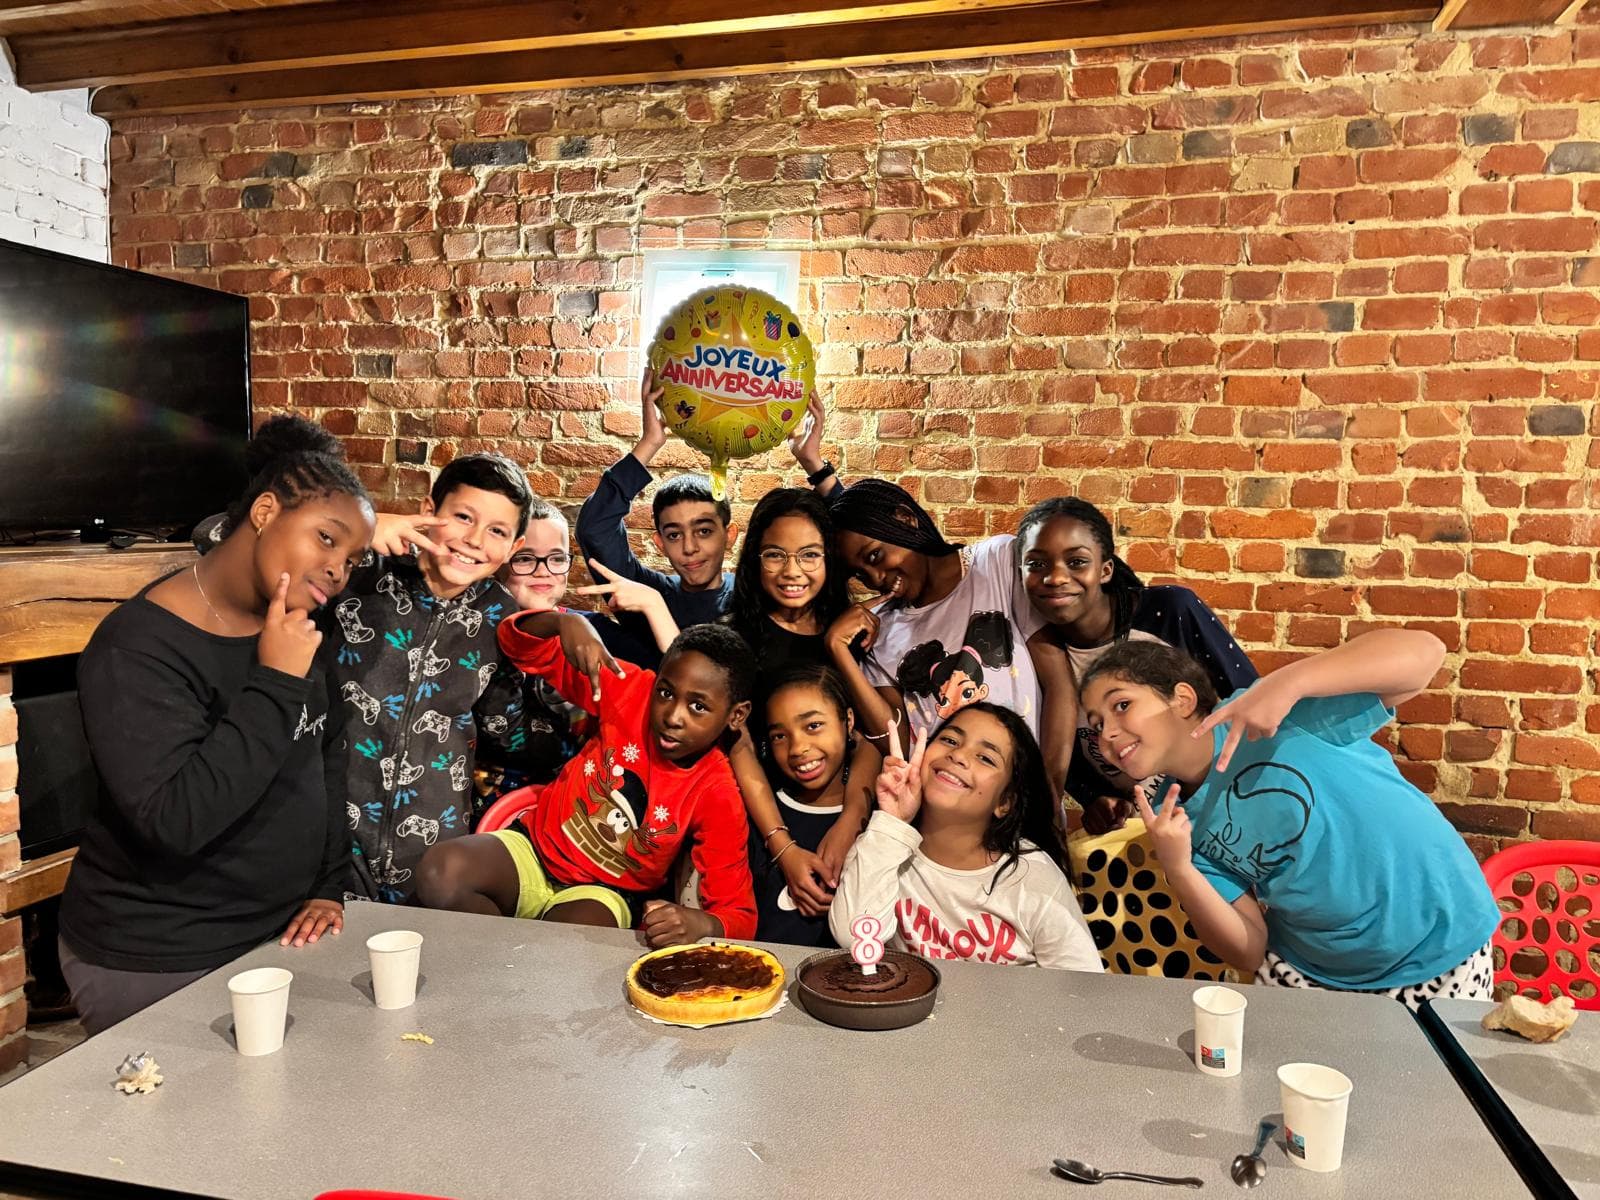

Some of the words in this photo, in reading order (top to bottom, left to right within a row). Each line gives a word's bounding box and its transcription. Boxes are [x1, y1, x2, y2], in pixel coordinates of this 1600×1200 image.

[659, 358, 804, 400] ANNIVERSAIRE
[684, 345, 786, 382] JOYEUX
[851, 915, 885, 965] 8
